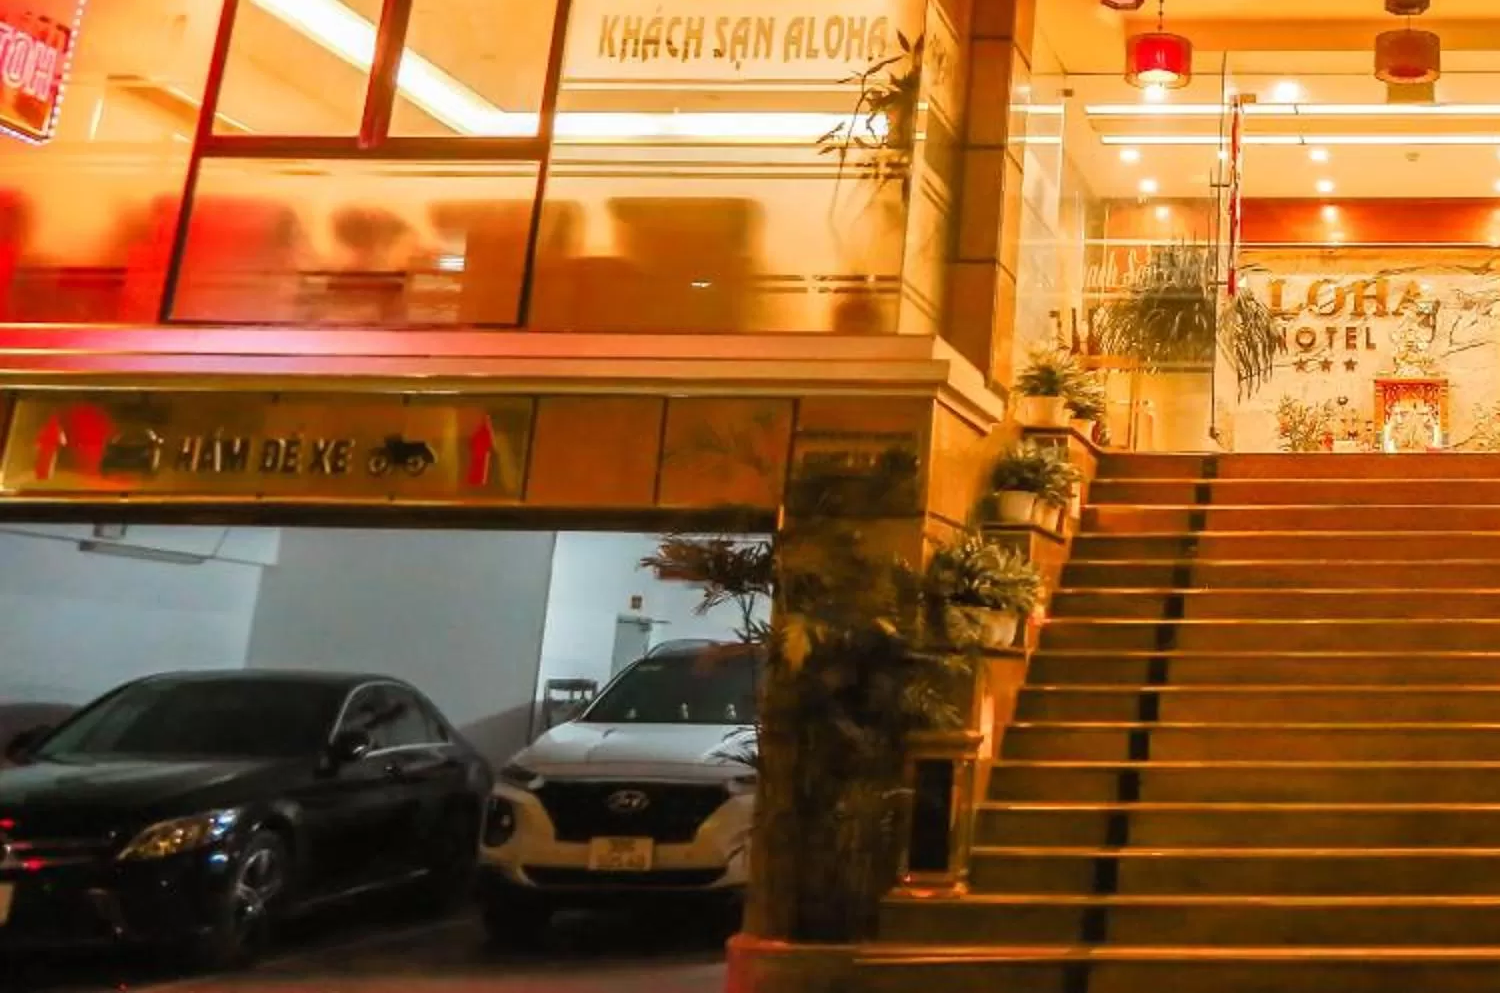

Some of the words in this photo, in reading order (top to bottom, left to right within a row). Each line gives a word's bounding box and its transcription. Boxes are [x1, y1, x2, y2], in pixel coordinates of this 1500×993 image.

[598, 4, 705, 63] KHÁCH
[782, 14, 888, 62] ALOHA
[1264, 277, 1424, 321] LOHA
